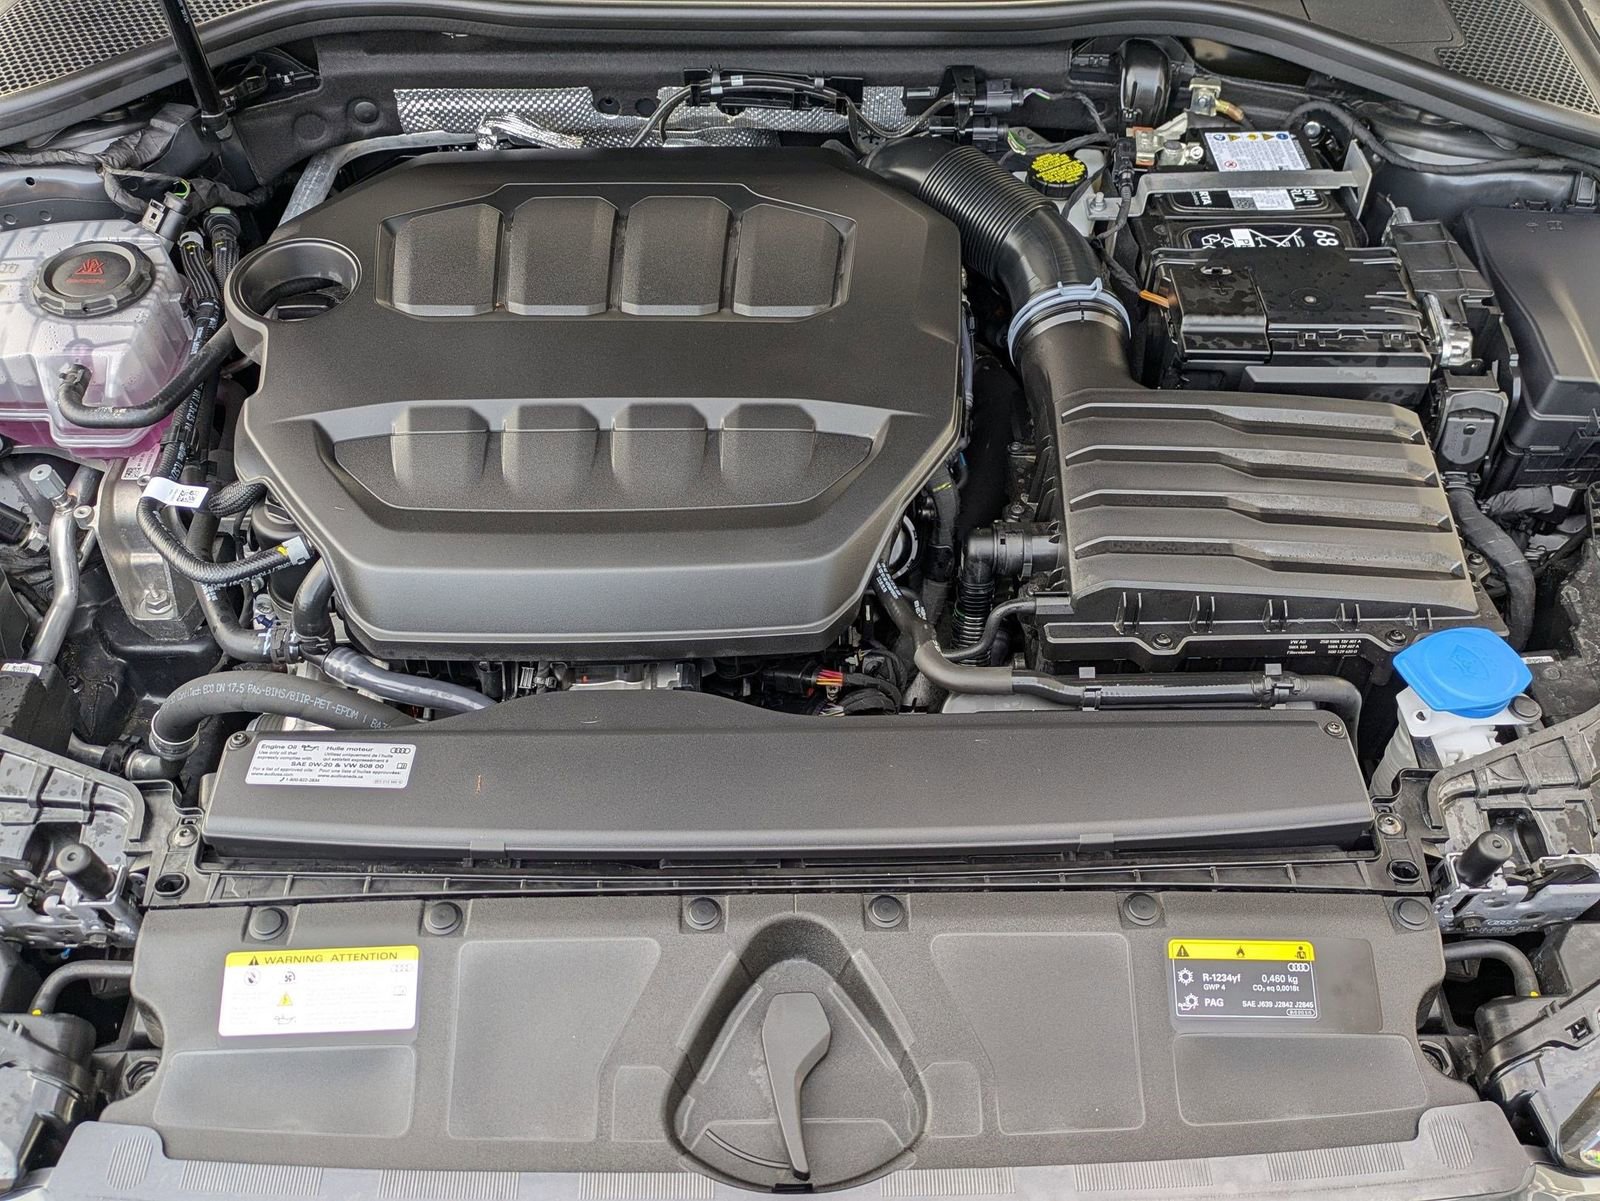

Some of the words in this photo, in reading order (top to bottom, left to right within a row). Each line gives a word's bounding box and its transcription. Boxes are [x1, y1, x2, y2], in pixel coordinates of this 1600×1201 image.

[1199, 190, 1212, 205] RTA
[1303, 189, 1319, 201] GM
[264, 954, 323, 965] WARNING
[330, 952, 398, 963] ATTENTION
[1202, 973, 1241, 984] R-1234yf
[1288, 974, 1298, 985] kg
[1204, 998, 1224, 1007] PAG
[1242, 1000, 1256, 1008] SAE
